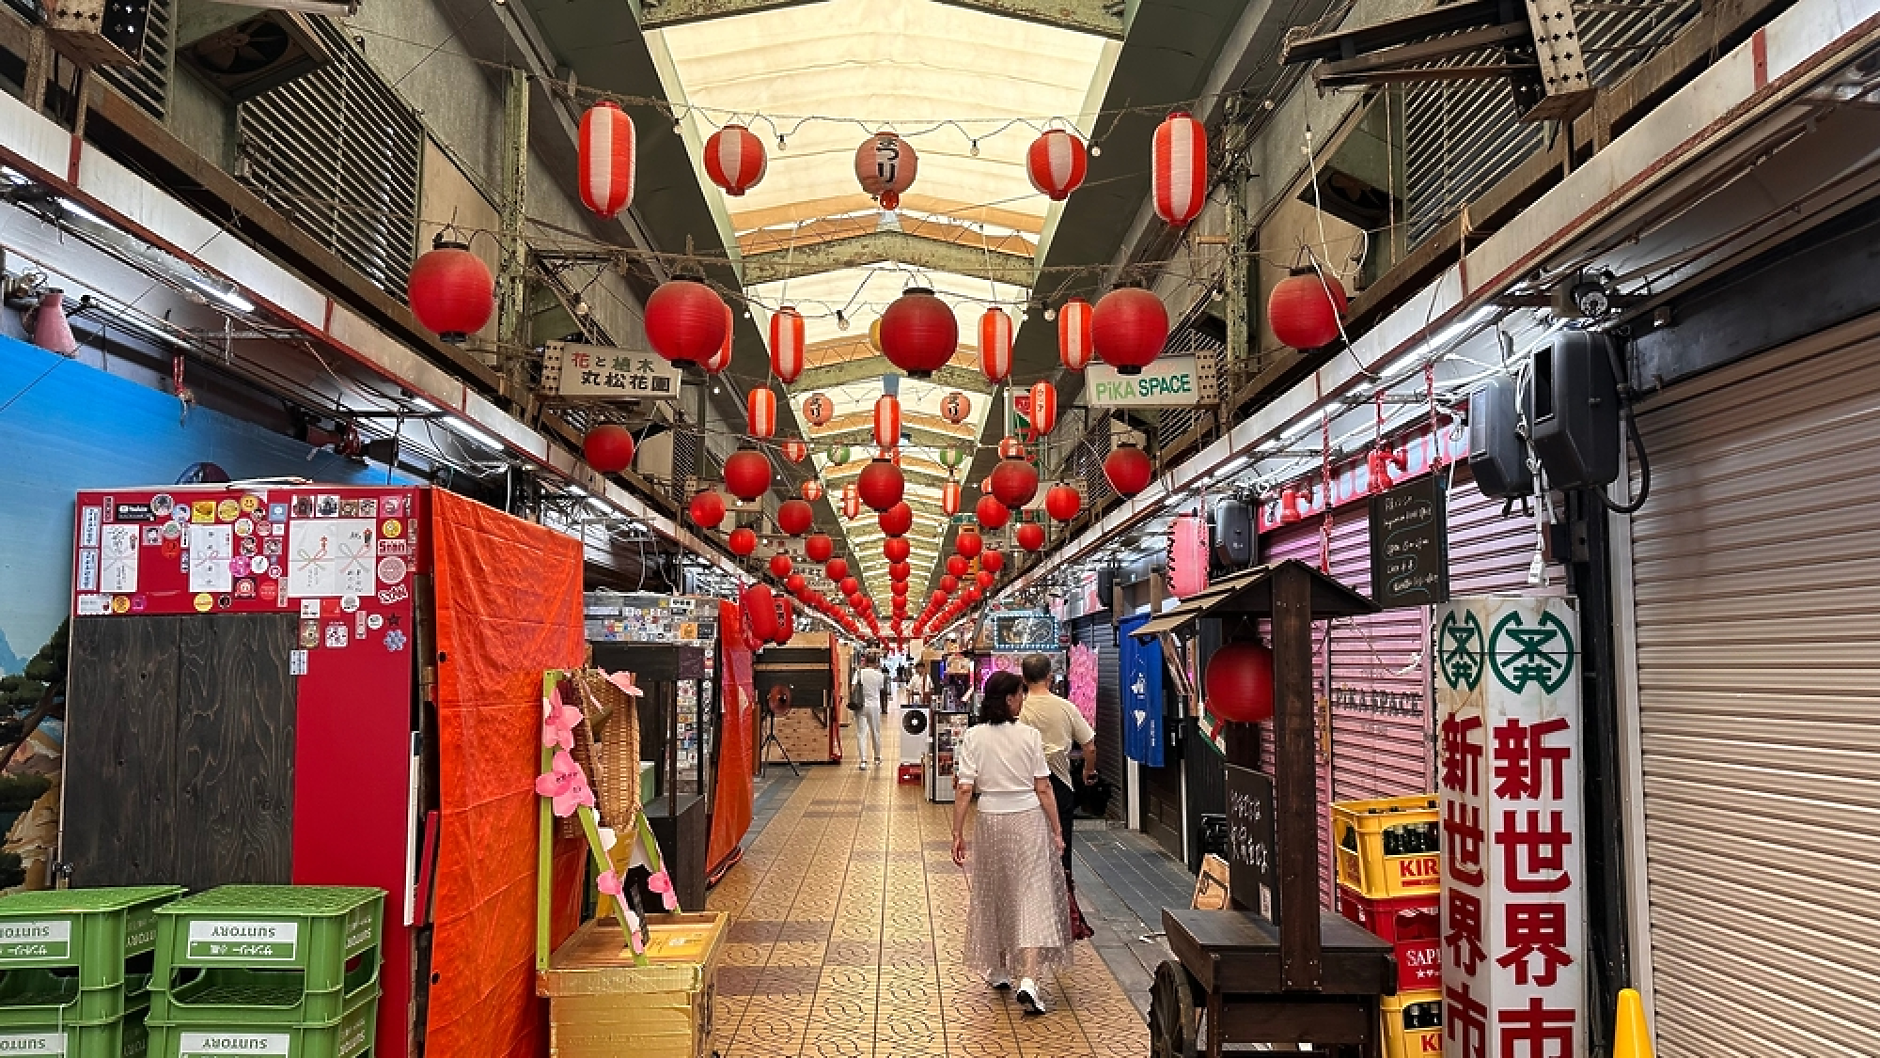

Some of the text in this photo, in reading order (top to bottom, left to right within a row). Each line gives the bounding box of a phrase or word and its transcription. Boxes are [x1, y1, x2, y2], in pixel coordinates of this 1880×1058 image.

[571, 352, 655, 373] 花と植木
[1138, 373, 1192, 397] SPACE
[211, 926, 276, 939] SUNTORY
[232, 944, 273, 956] サントリー
[202, 1038, 268, 1050] SUNTORY
